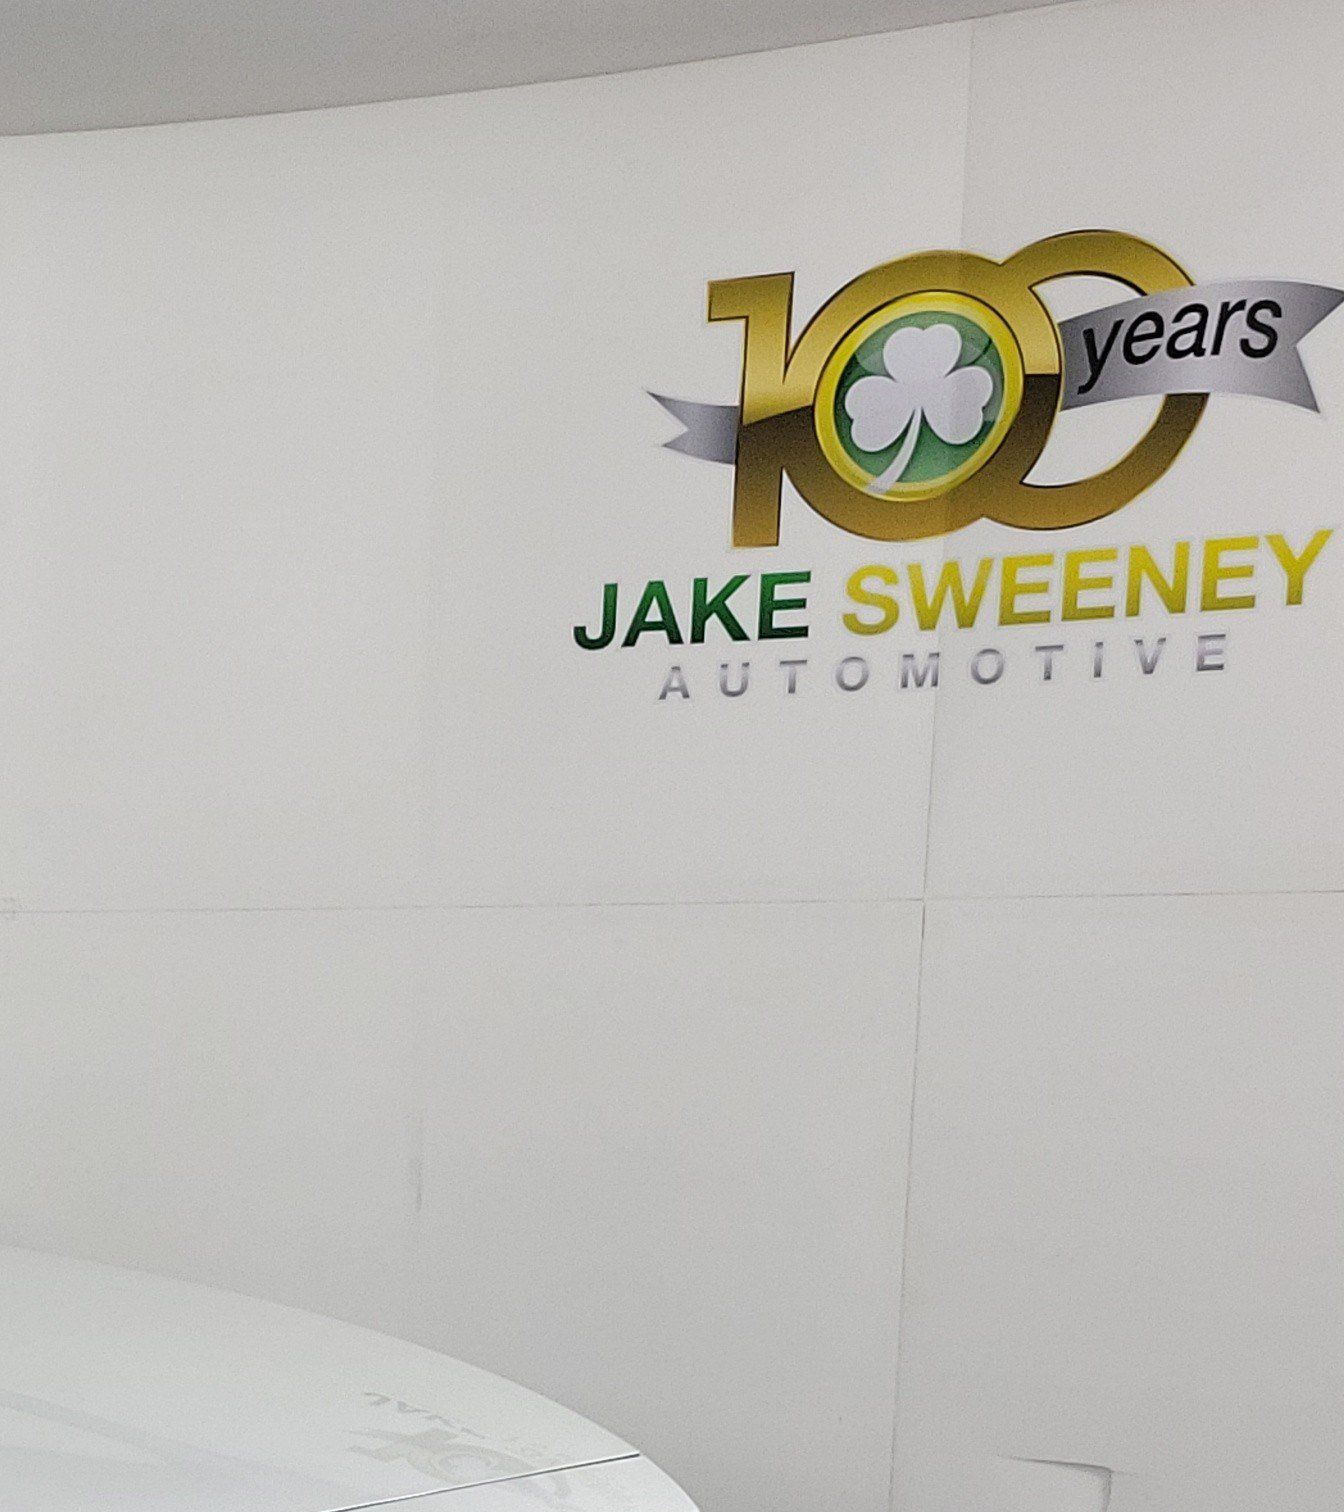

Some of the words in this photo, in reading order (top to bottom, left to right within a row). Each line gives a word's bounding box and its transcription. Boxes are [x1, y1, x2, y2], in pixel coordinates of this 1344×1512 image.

[707, 229, 1210, 549] 100
[1077, 297, 1282, 394] years
[573, 570, 812, 651] JAKE
[842, 529, 1333, 636] SWEENEY
[659, 633, 1227, 701] AUTOMOTIVE
